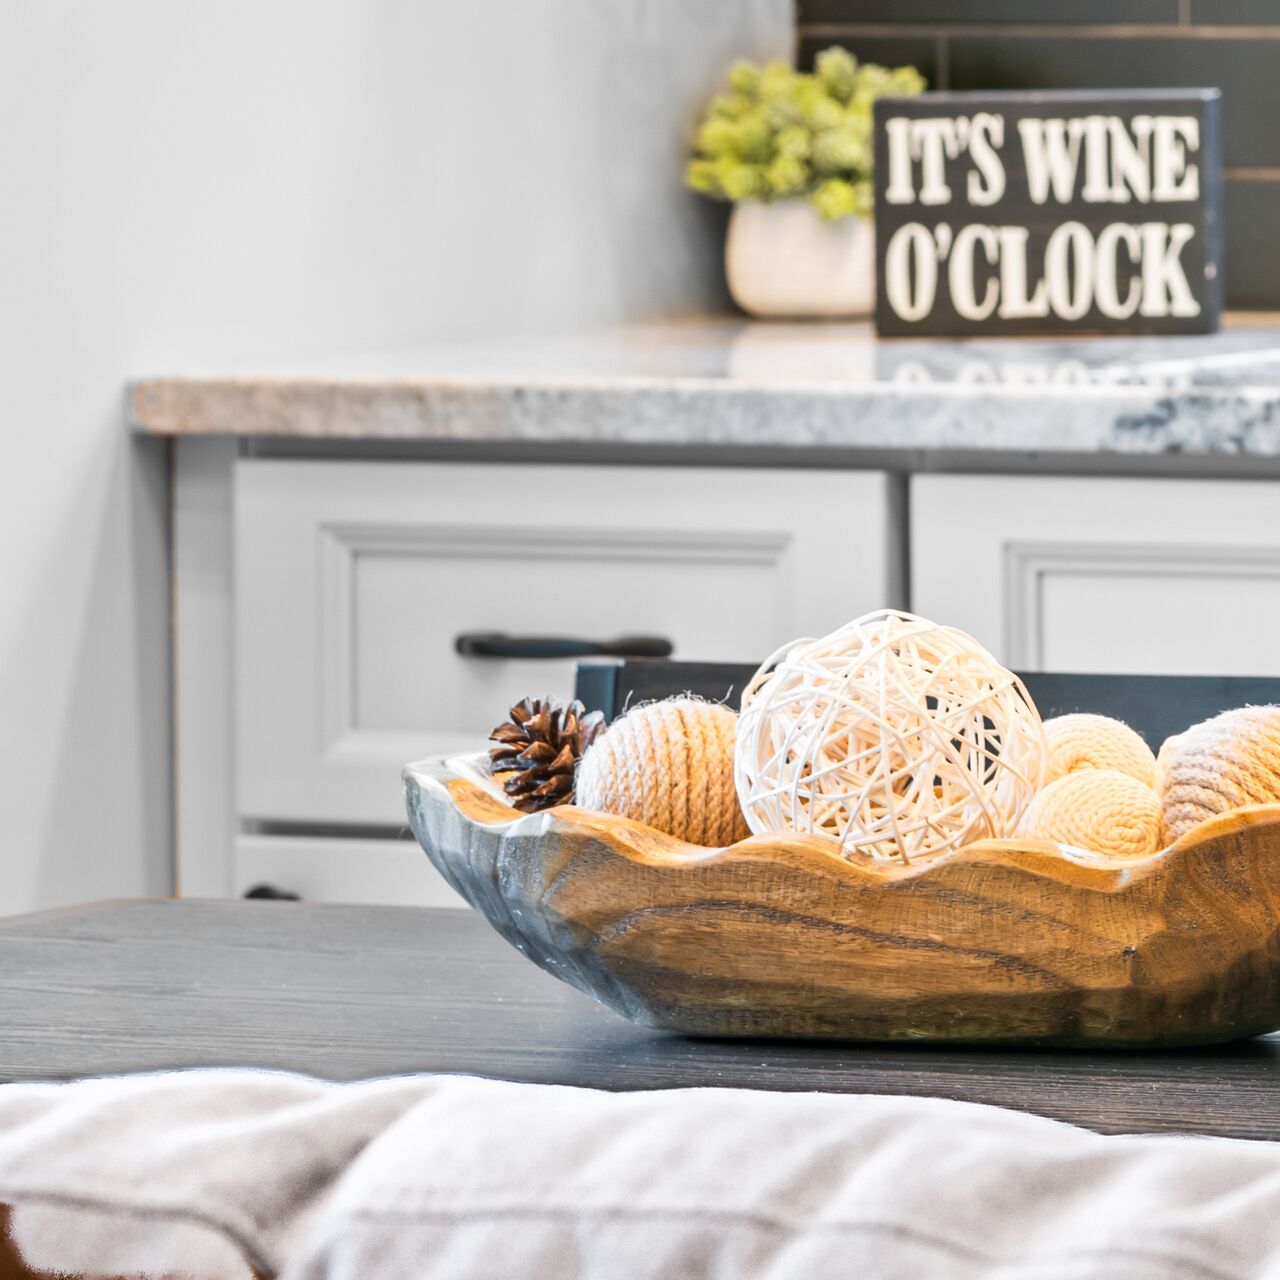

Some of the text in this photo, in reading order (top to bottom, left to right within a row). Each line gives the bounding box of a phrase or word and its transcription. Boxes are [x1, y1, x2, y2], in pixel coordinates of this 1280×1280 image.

[884, 112, 1200, 206] IT'S WINE
[885, 221, 1201, 322] O'CLOCK
